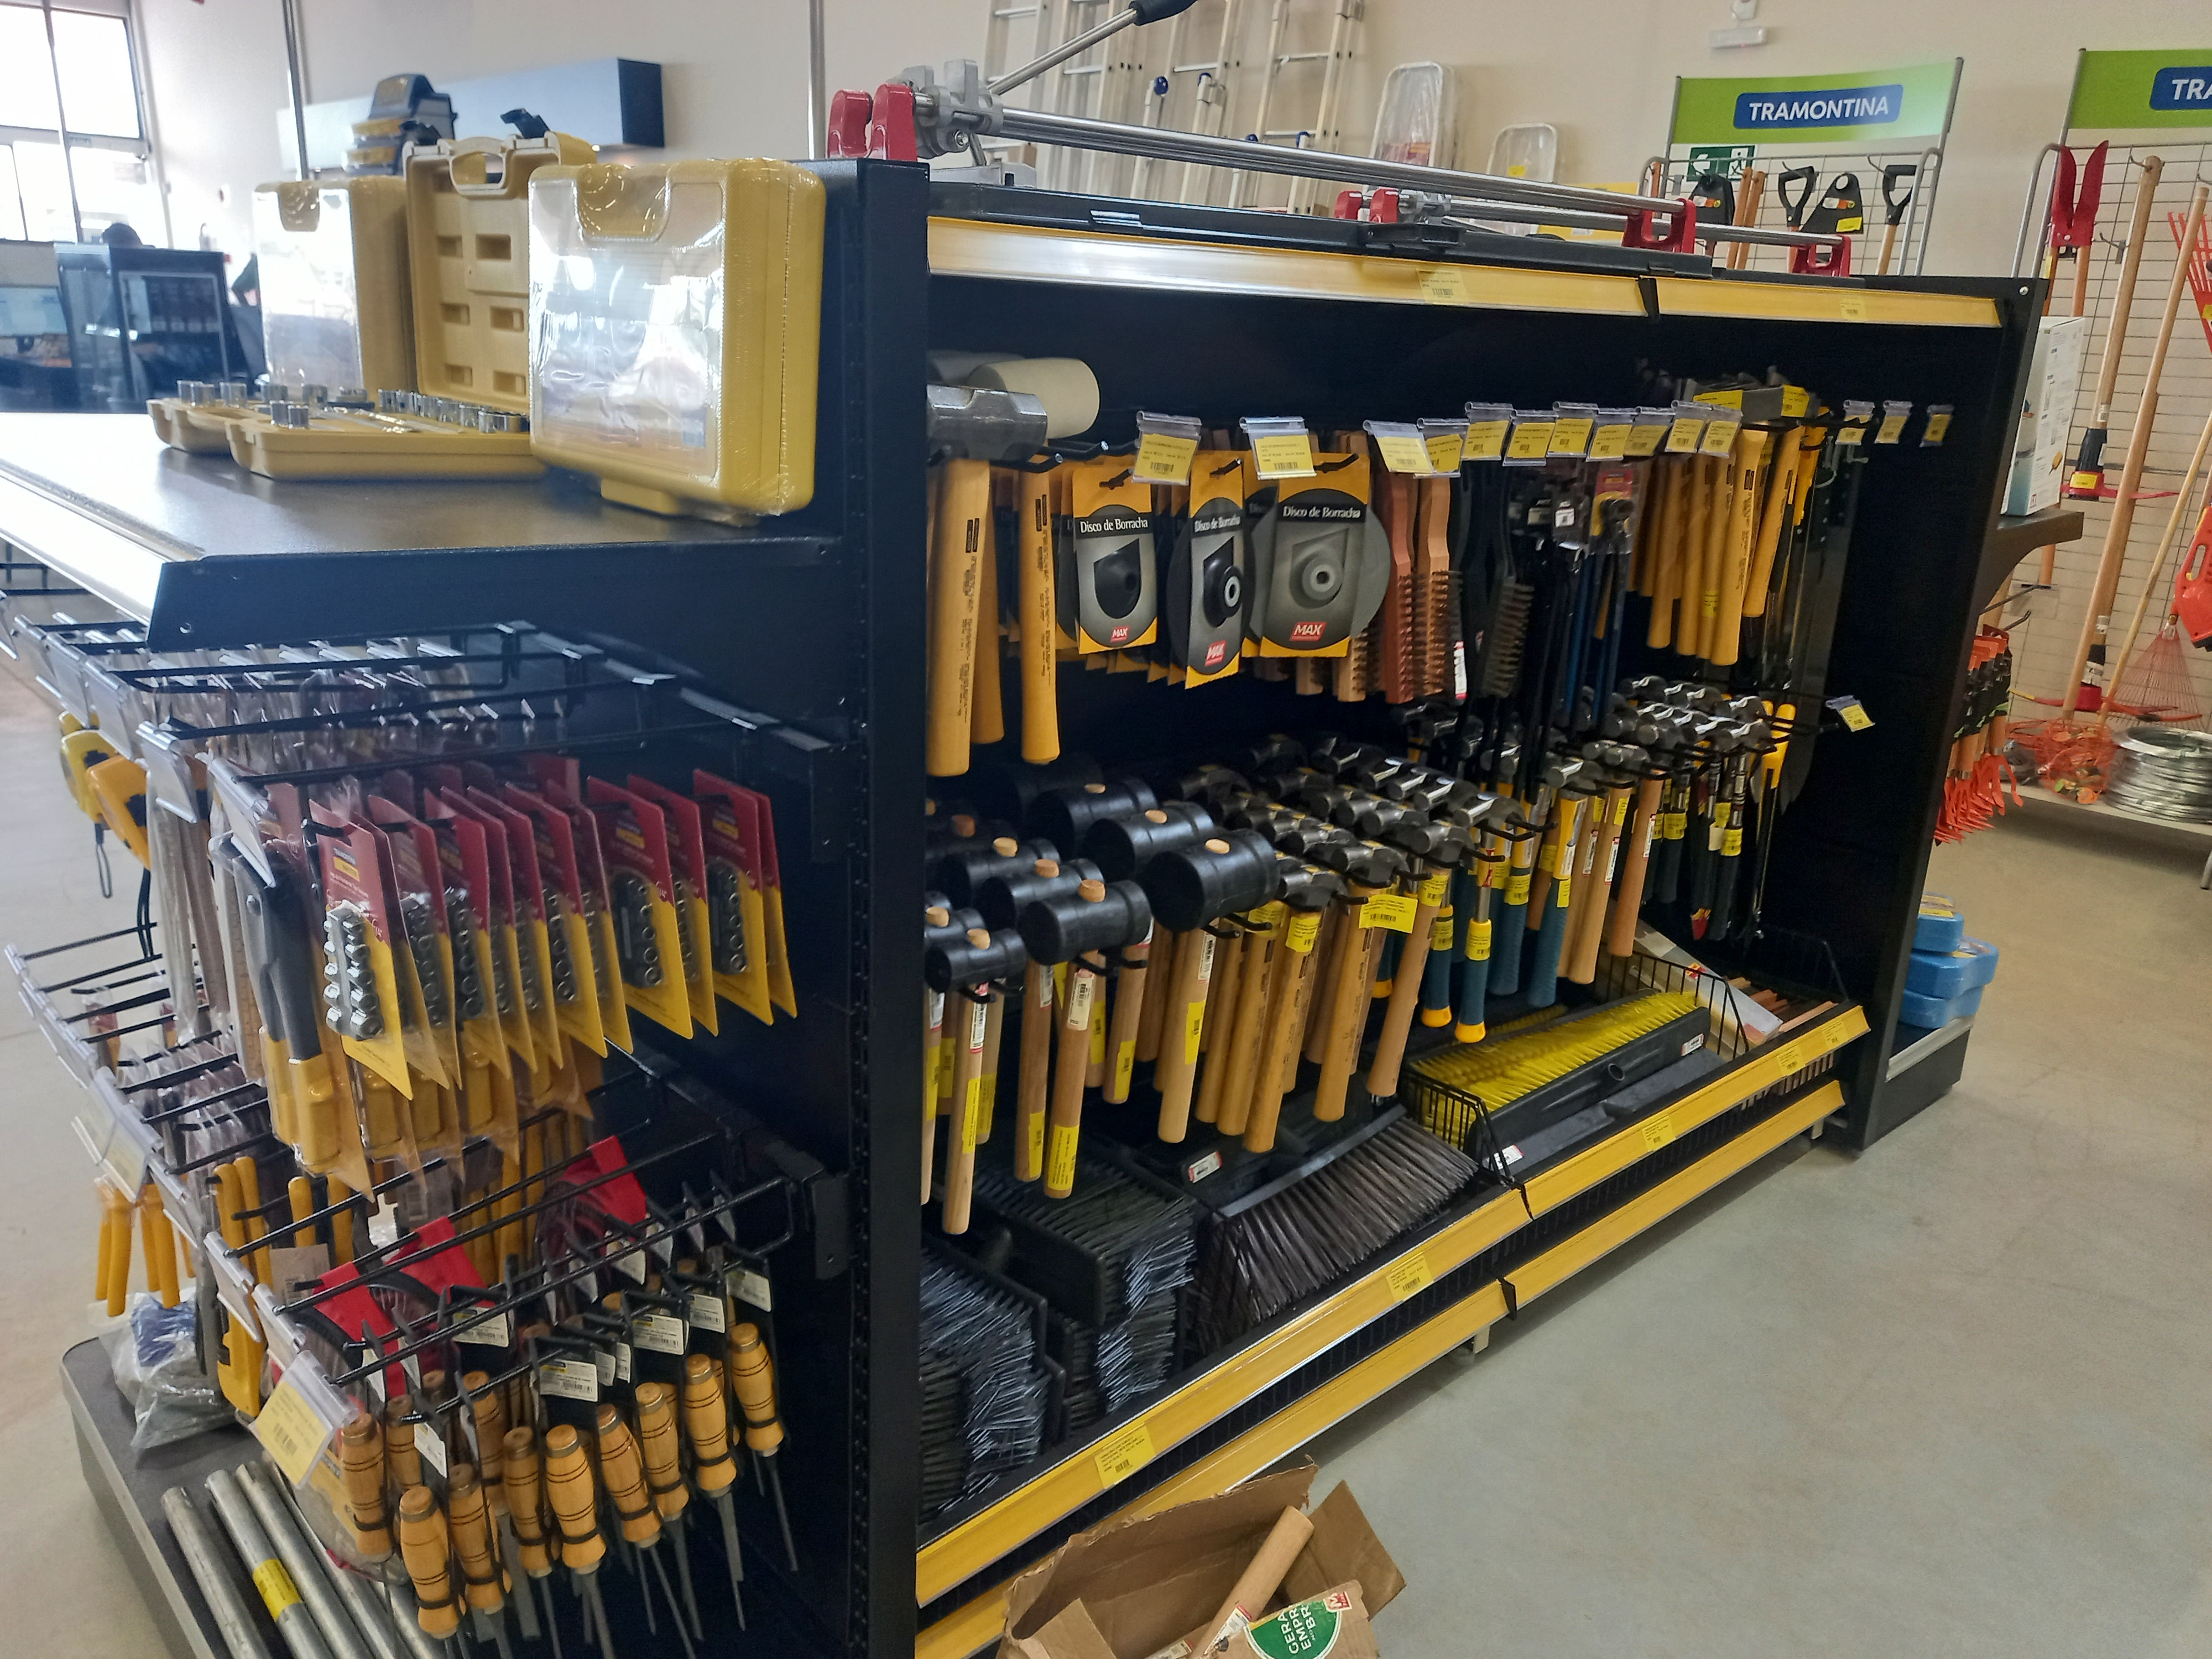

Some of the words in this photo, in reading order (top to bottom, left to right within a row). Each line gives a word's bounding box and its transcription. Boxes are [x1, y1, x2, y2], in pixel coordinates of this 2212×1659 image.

[1749, 96, 1888, 121] TRAMONTINA
[1282, 505, 1307, 517] Disco
[1308, 506, 1321, 517] de
[1322, 507, 1361, 519] Borracha
[1080, 520, 1102, 533] Disco
[1103, 519, 1114, 531] de
[1115, 517, 1148, 530] Borracha
[1194, 520, 1210, 533] Disco
[1211, 518, 1218, 529] de
[1112, 628, 1128, 638] MAX
[1293, 624, 1322, 635] MAX
